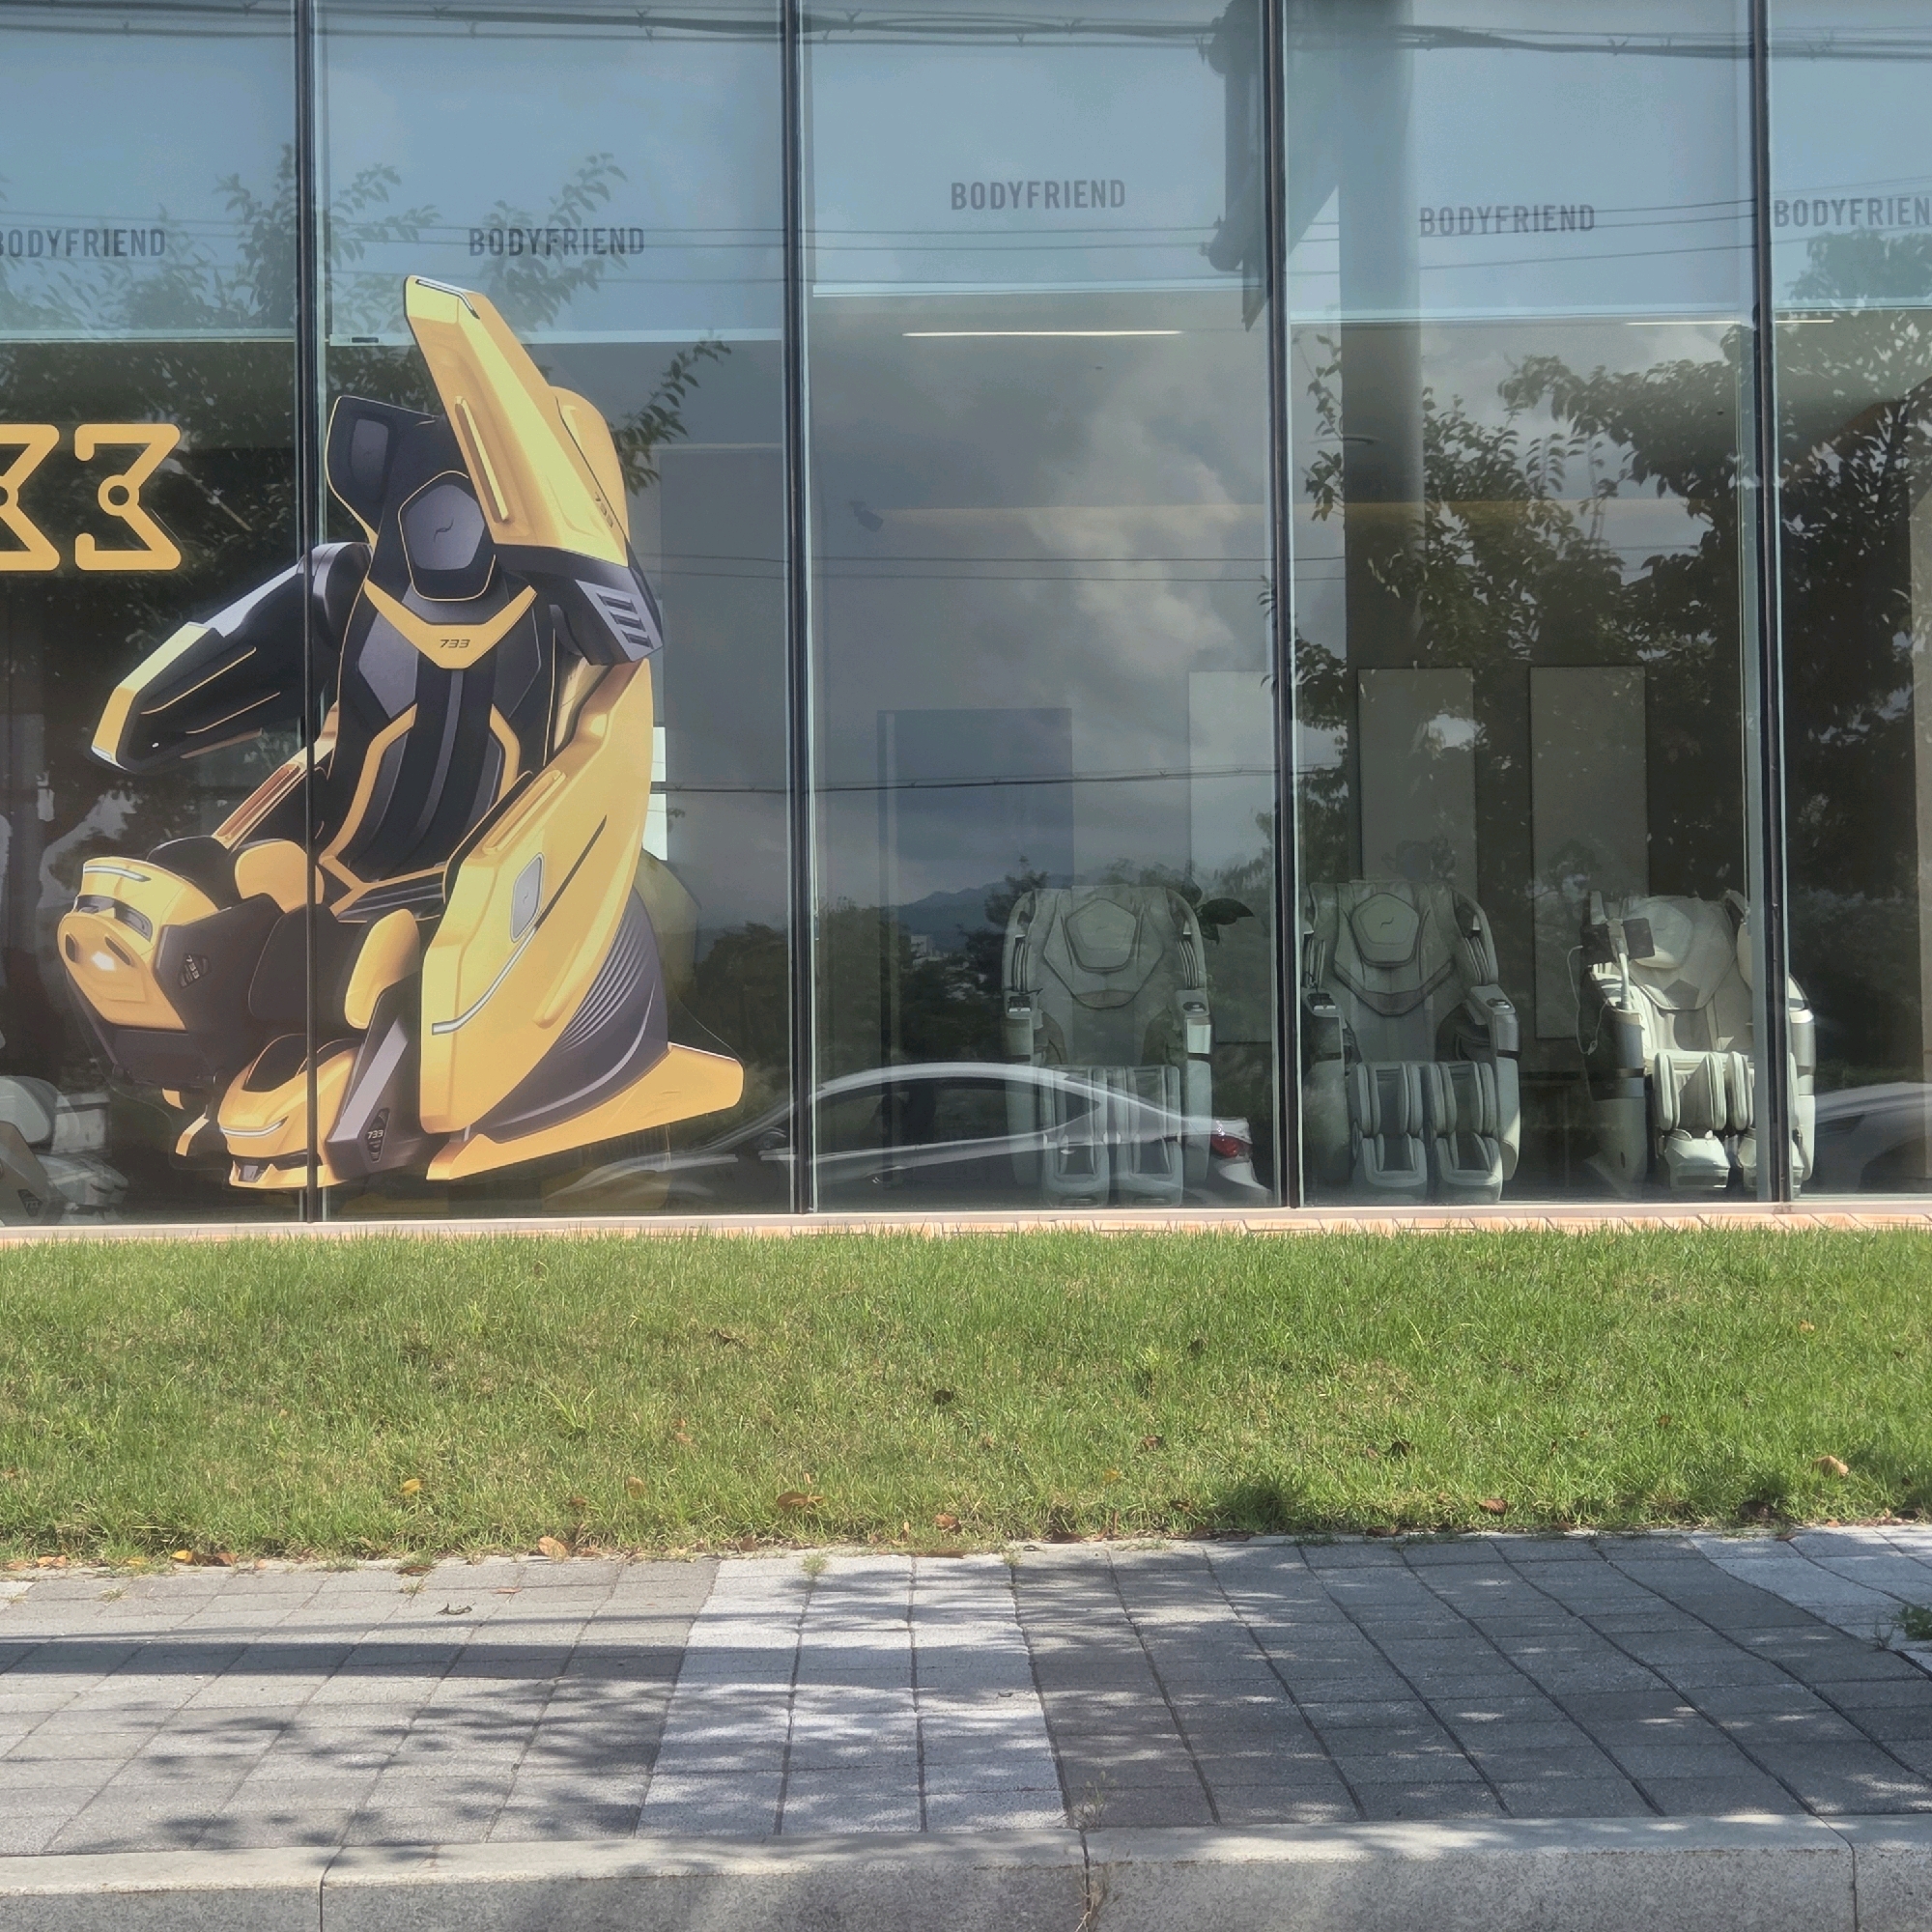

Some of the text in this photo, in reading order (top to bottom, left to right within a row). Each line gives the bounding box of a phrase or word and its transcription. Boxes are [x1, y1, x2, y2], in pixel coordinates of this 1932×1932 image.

[951, 179, 1126, 211] BODYFRIEND
[1419, 204, 1596, 238] BODYFRIEND
[1773, 196, 1931, 228] BODYFRIEN
[0, 228, 166, 258] ODYFRIEND
[469, 227, 645, 257] BODYFRIEND
[440, 639, 470, 649] 733
[367, 1129, 384, 1140] 733
